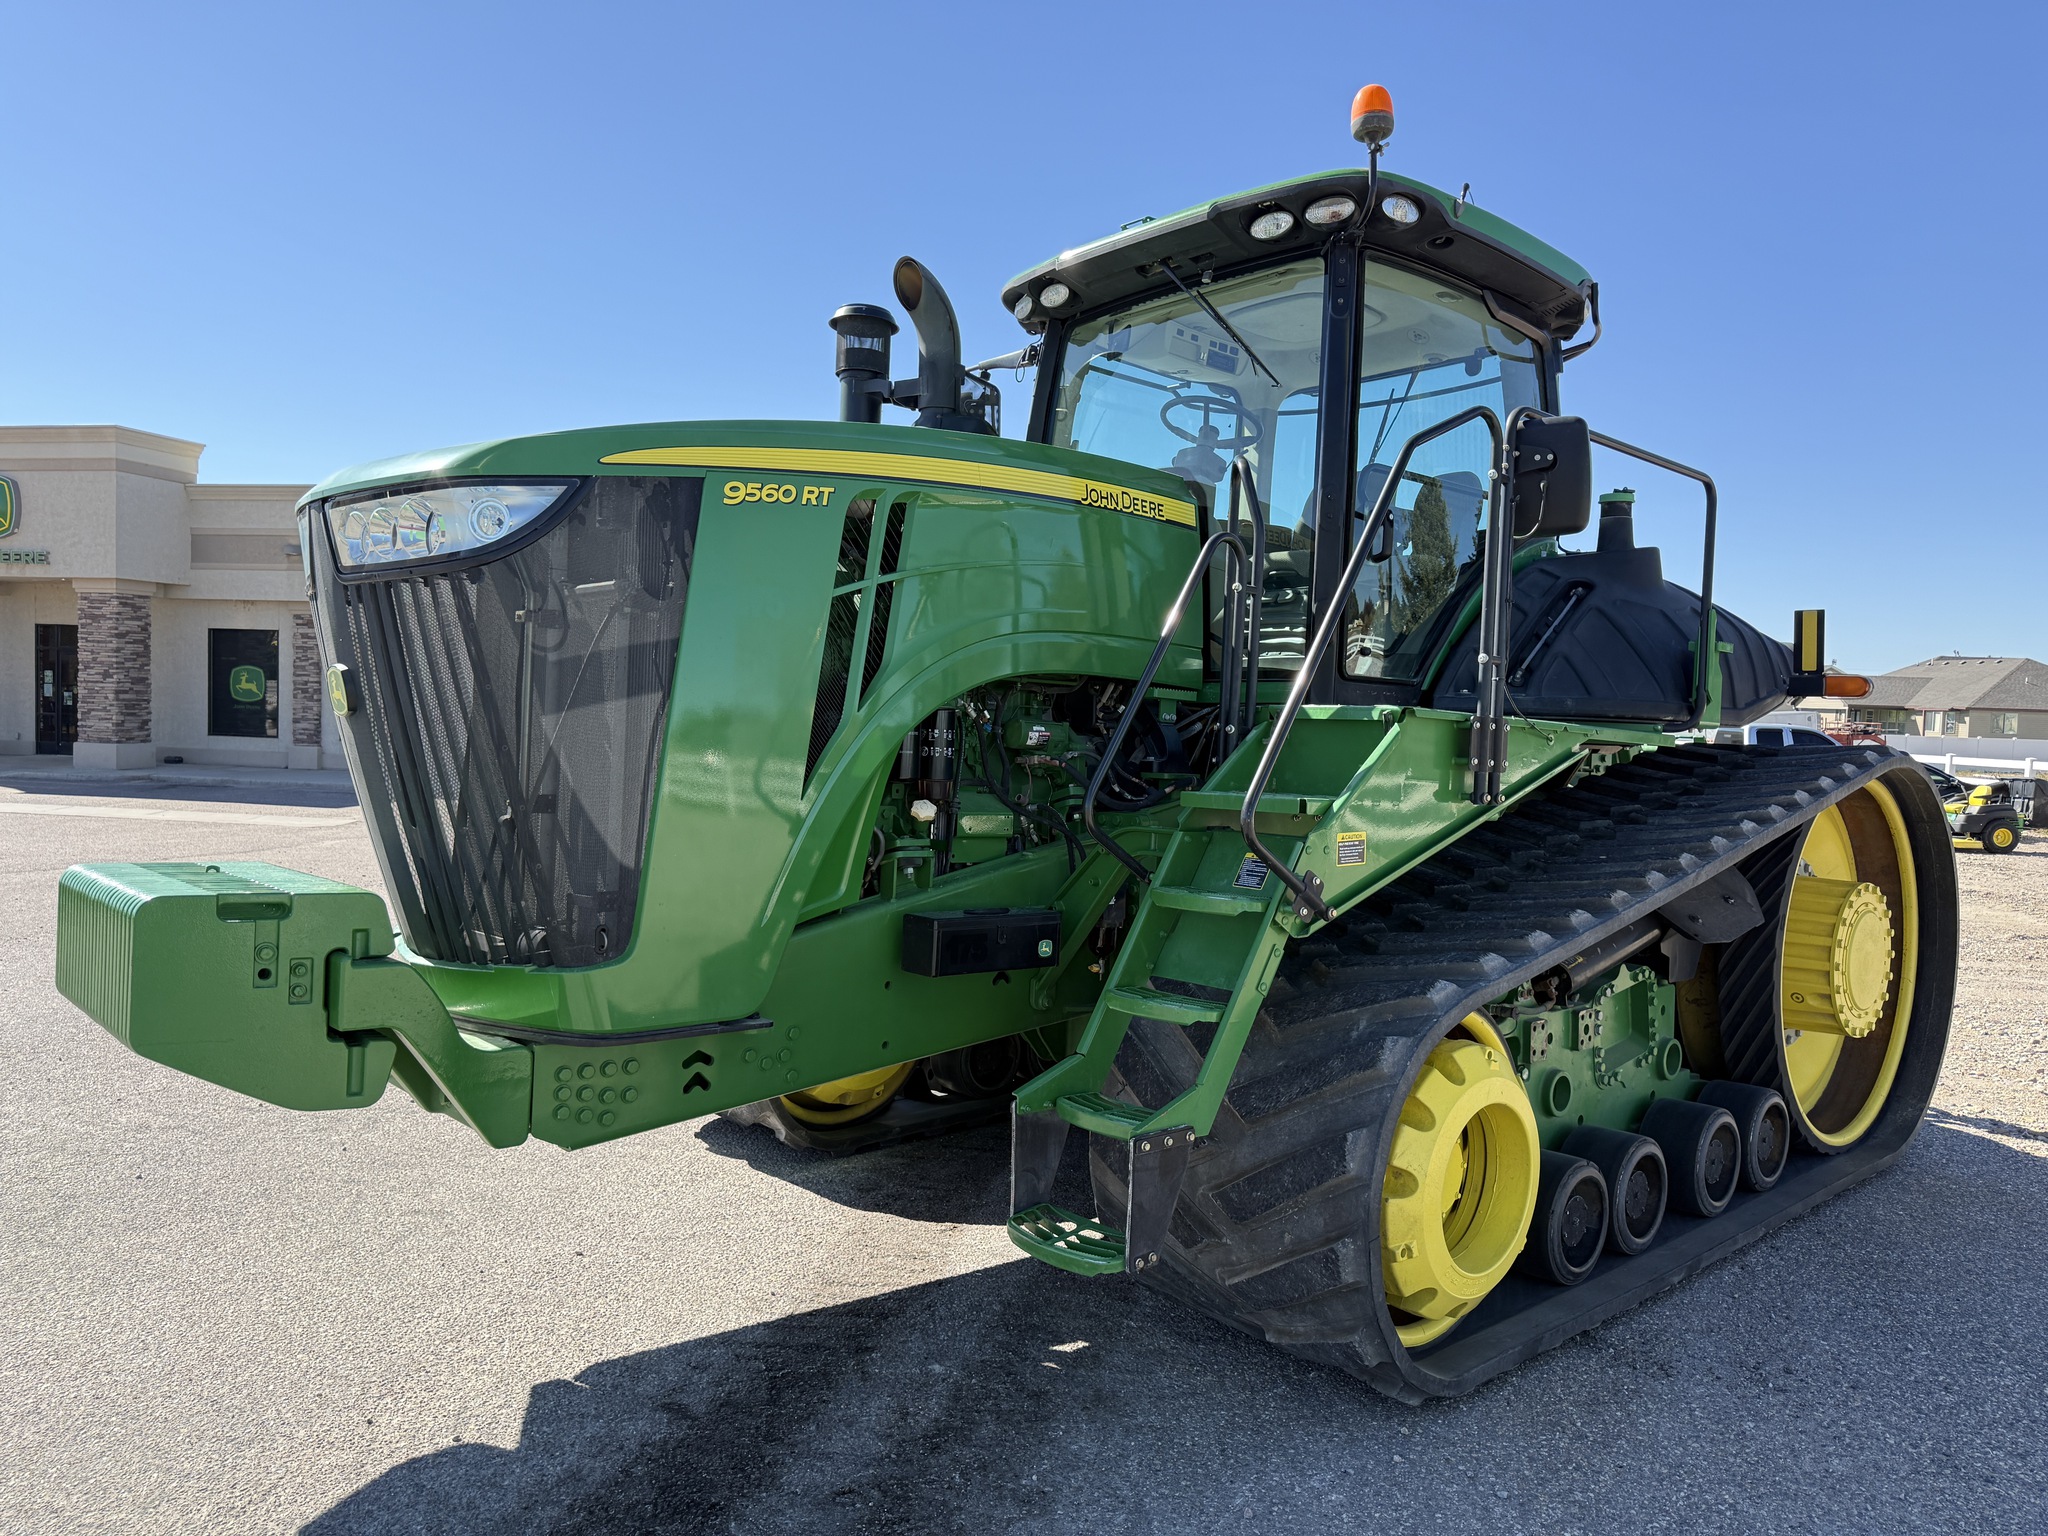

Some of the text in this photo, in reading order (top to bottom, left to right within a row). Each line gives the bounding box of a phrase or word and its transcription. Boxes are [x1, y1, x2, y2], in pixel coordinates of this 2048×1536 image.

[723, 481, 836, 507] 9560 RT
[1081, 483, 1165, 518] JOHN DEERE
